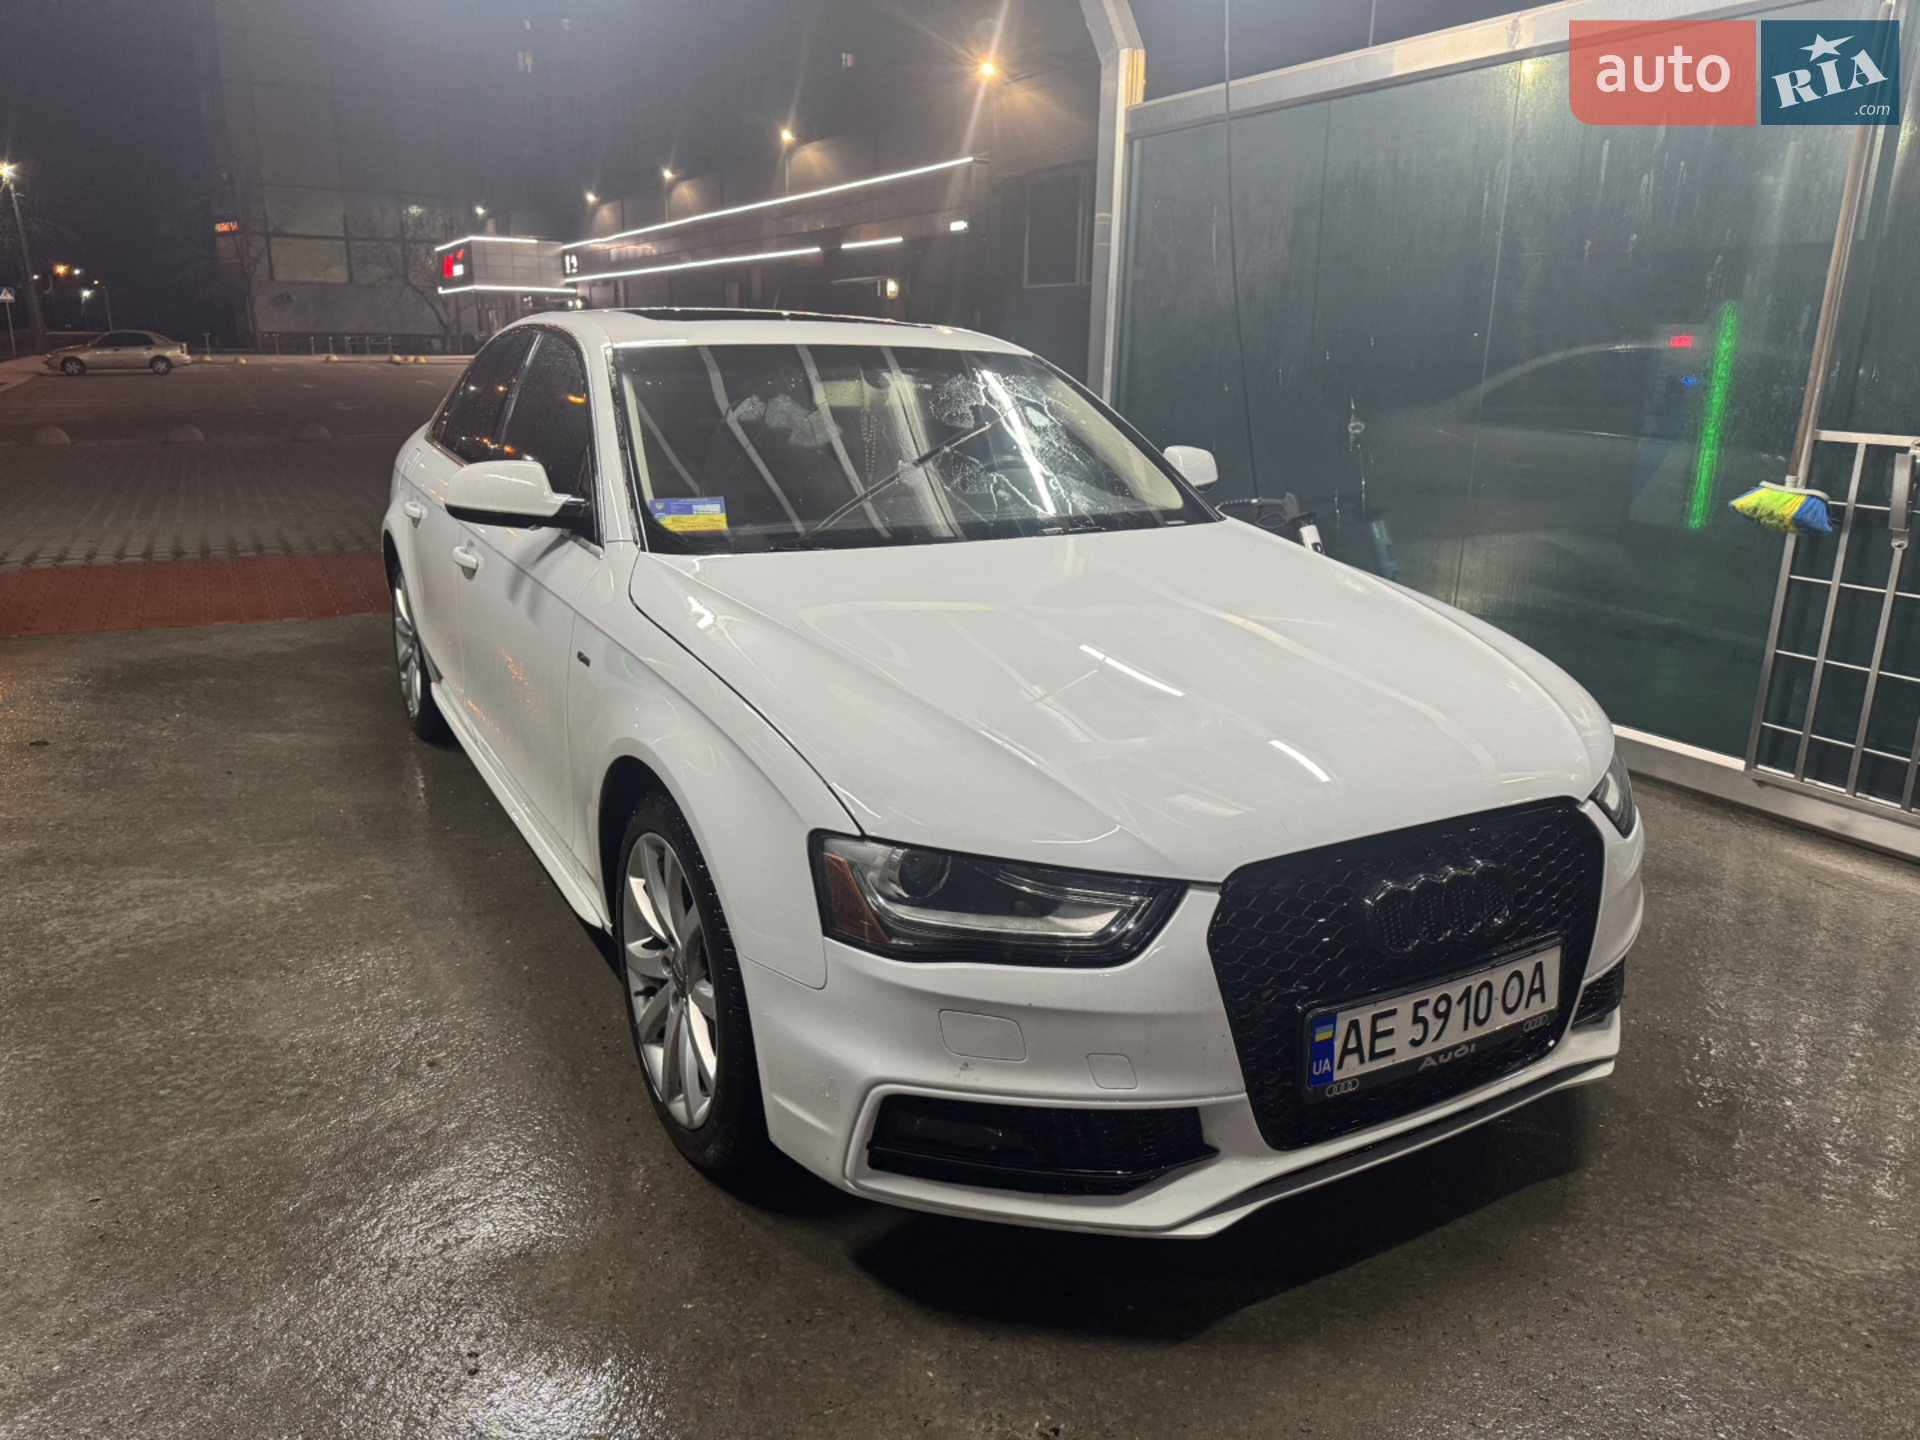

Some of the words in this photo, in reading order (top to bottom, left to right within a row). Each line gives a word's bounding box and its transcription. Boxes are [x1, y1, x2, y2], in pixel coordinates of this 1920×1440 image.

[1336, 1008, 1398, 1071] AE
[1408, 979, 1494, 1048] 5910
[1500, 961, 1547, 1015] OA
[1312, 1057, 1332, 1076] UA
